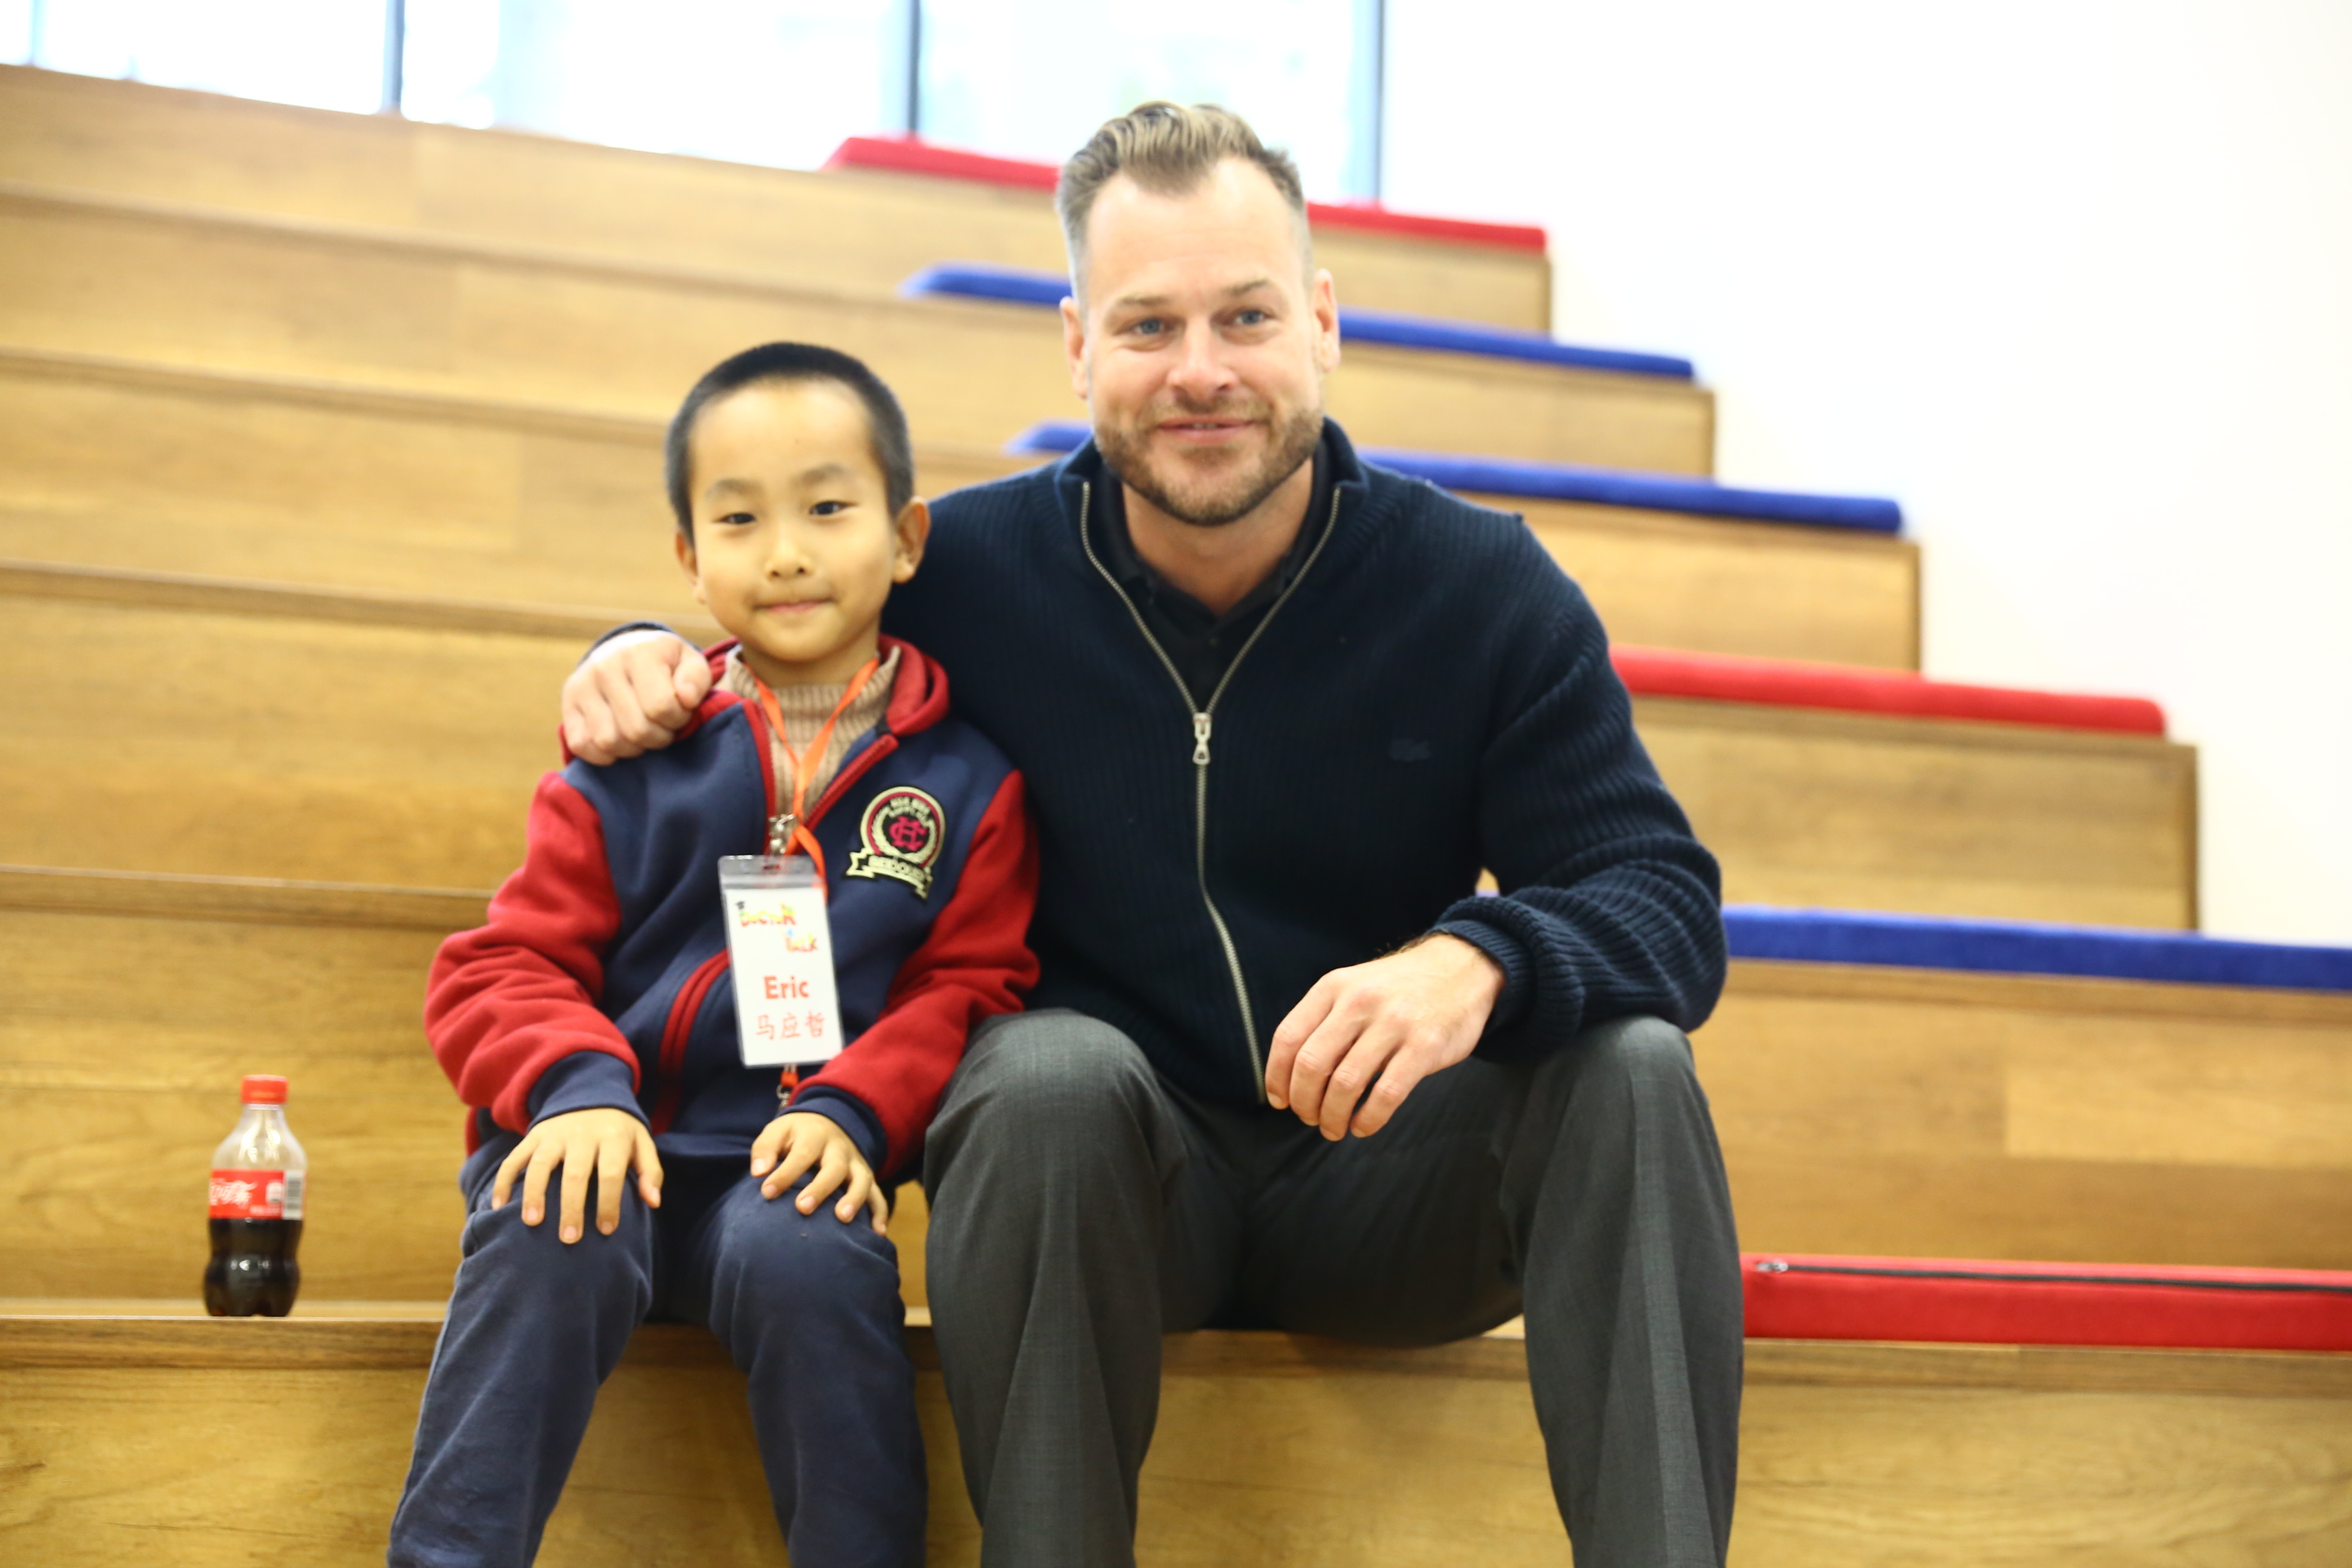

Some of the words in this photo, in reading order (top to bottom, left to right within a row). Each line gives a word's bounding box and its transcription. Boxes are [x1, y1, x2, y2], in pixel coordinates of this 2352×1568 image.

[764, 976, 809, 999] Eric
[755, 1011, 825, 1040] 马应哲
